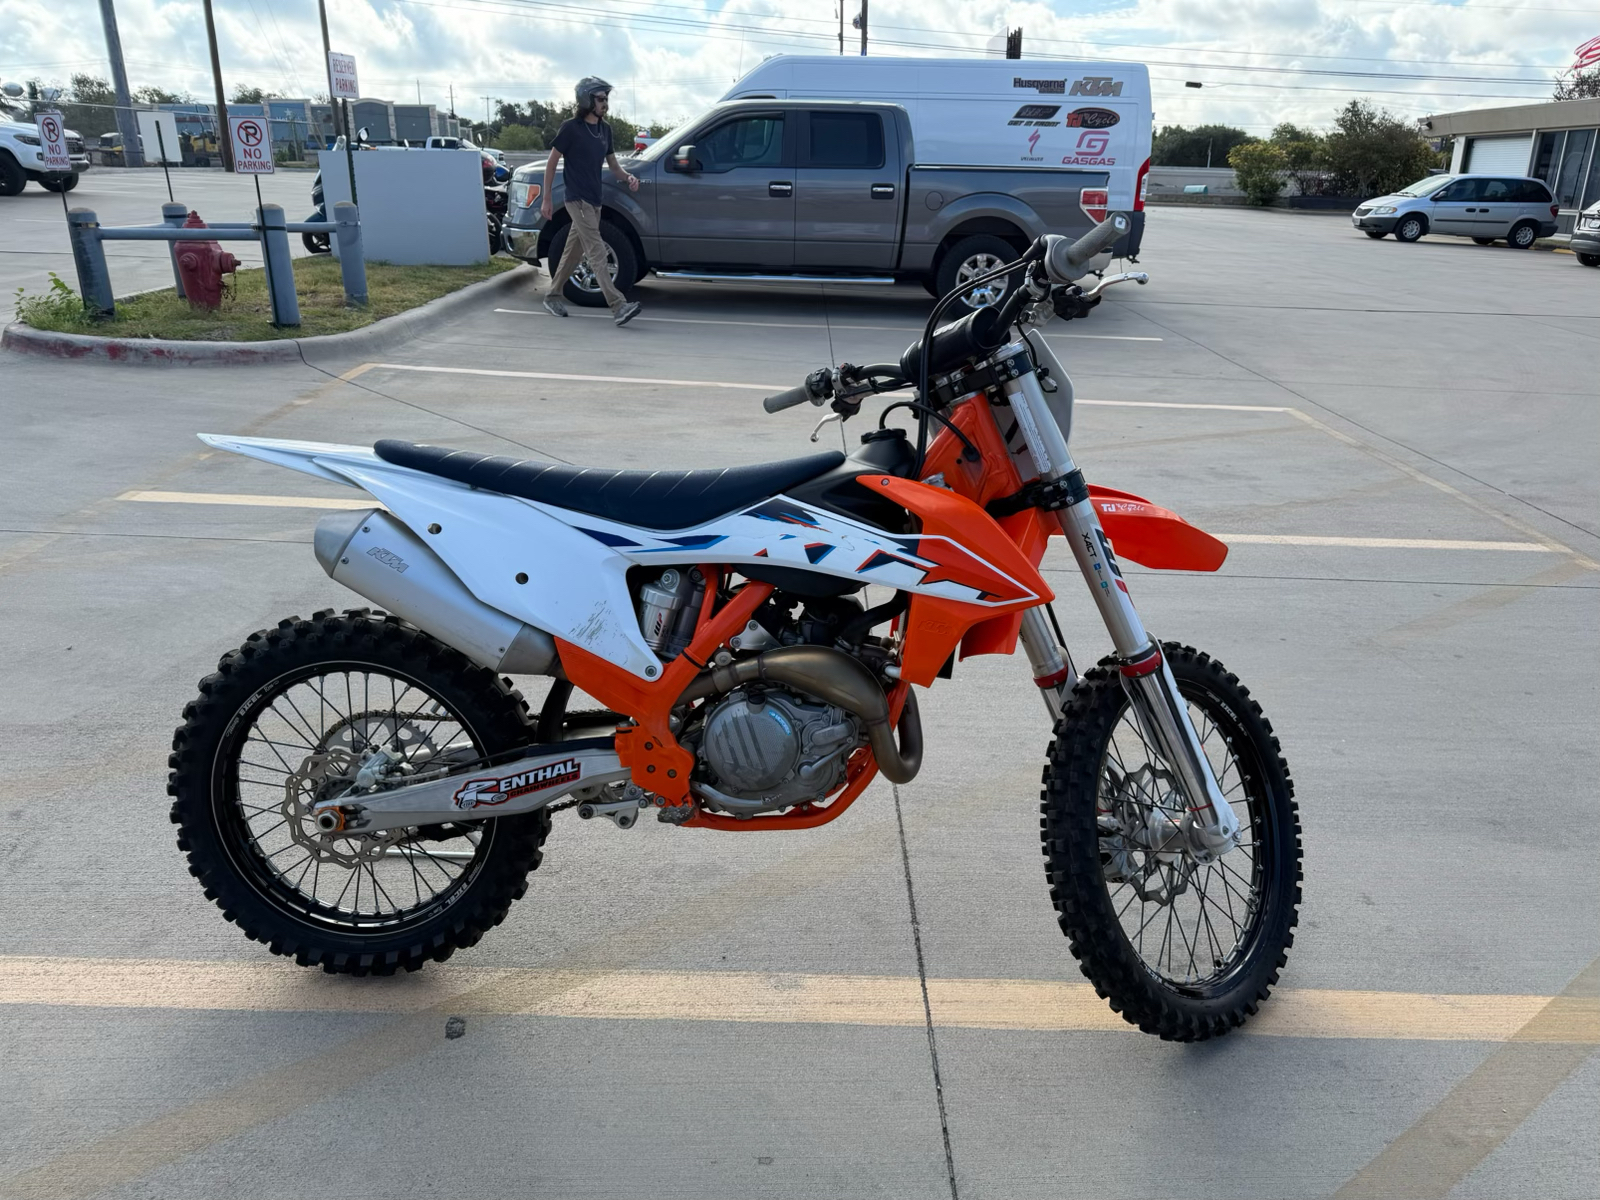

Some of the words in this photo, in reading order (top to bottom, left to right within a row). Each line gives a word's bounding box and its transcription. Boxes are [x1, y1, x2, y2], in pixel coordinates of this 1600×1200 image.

[333, 58, 355, 75] RESERVED
[335, 77, 357, 93] PARKING
[1013, 77, 1067, 90] Husqvarna
[1069, 76, 1123, 96] KTM
[48, 144, 61, 155] NO
[243, 147, 262, 159] NO
[45, 156, 69, 166] PARKING
[237, 160, 272, 170] PARKING
[1062, 156, 1117, 165] GASGAS
[1081, 532, 1098, 557] XACT
[366, 546, 409, 573] KTM
[239, 693, 263, 716] EXCEL
[510, 773, 578, 797] CHAINWHEELS
